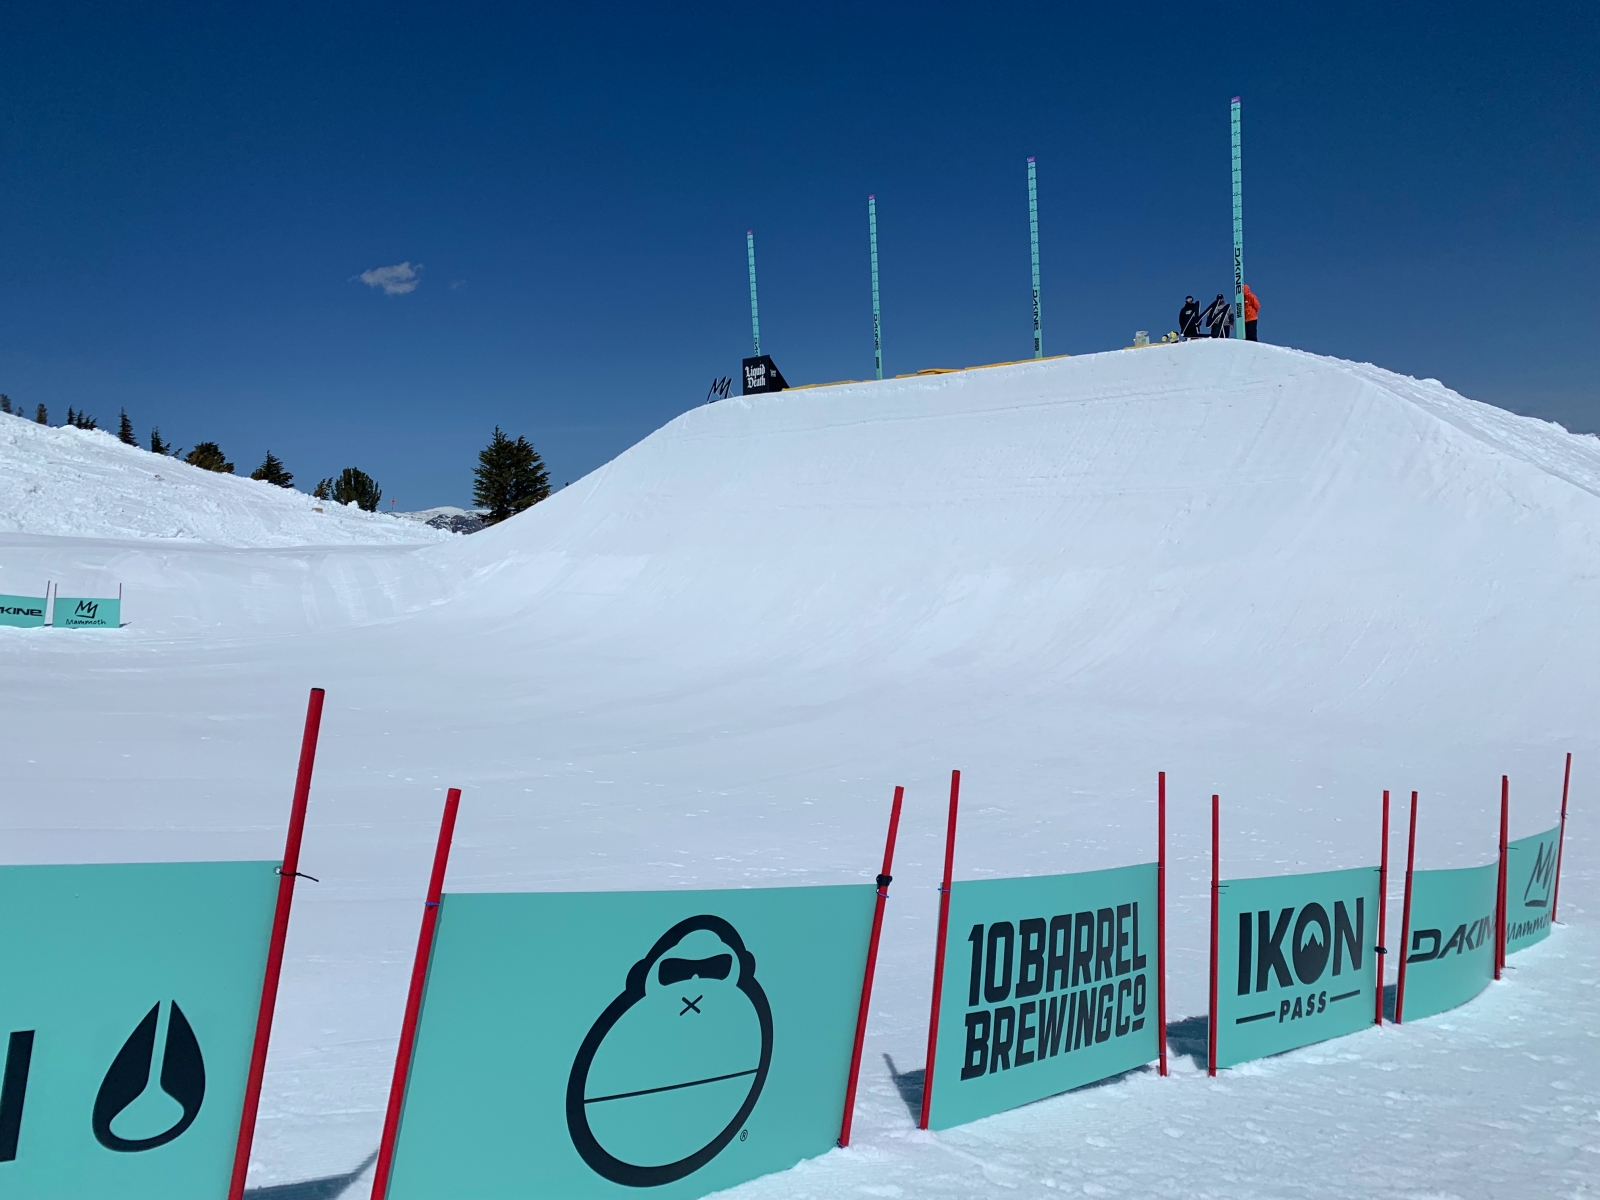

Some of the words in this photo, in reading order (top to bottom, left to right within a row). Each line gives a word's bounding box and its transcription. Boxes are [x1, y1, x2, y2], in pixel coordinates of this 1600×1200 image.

[1234, 247, 1242, 296] DAKINE
[745, 363, 766, 379] Liquid
[746, 375, 766, 389] Death
[0, 607, 43, 617] KINE
[1237, 896, 1365, 996] IKON
[1406, 909, 1497, 963] DAKIN
[1278, 991, 1327, 1023] PASS
